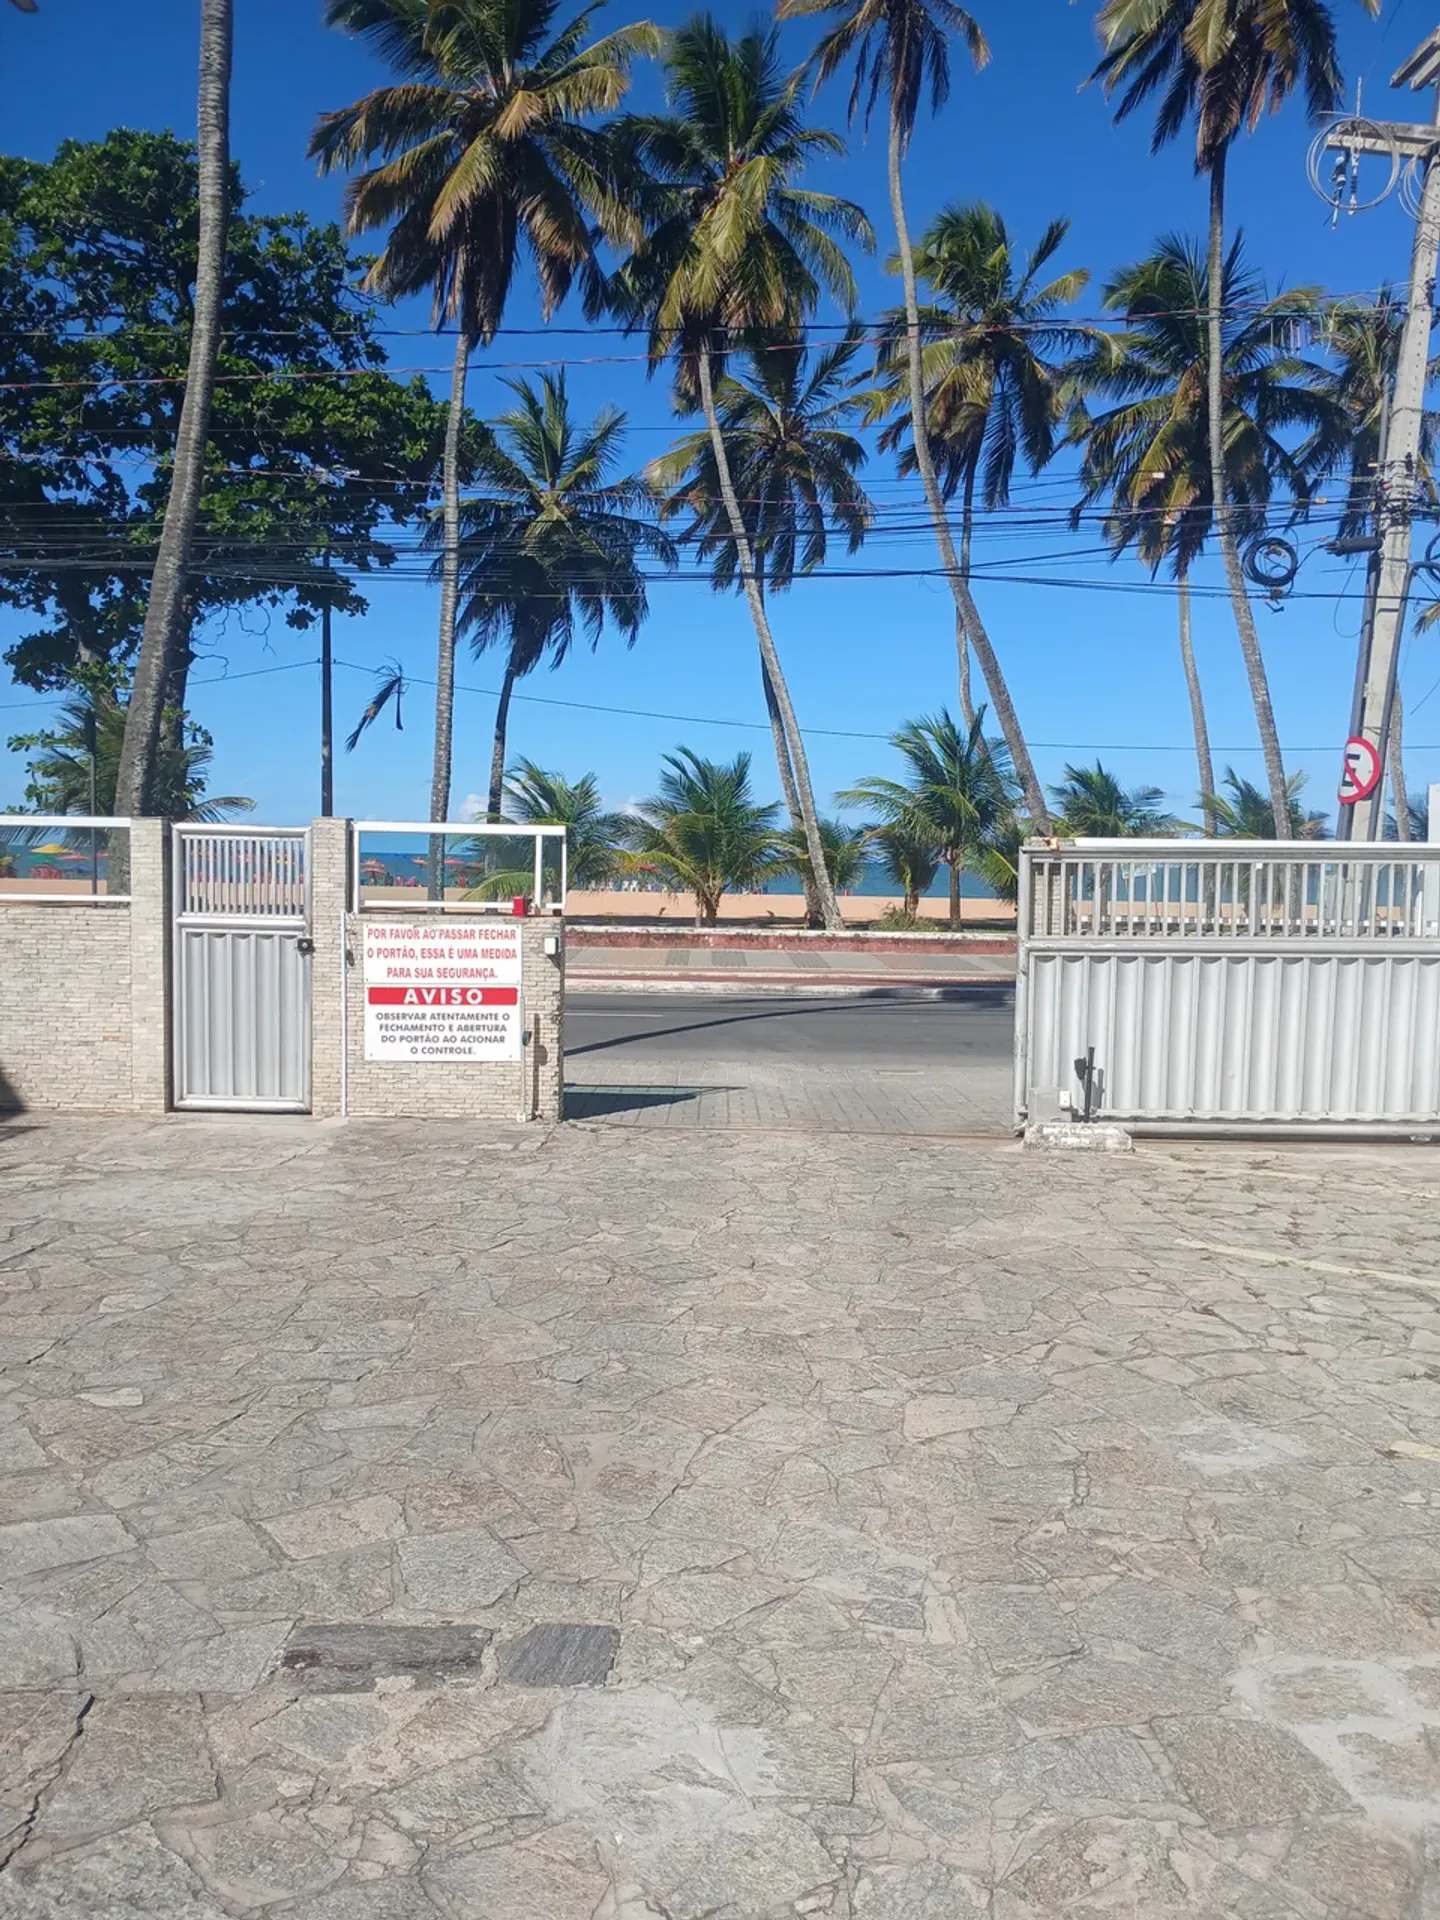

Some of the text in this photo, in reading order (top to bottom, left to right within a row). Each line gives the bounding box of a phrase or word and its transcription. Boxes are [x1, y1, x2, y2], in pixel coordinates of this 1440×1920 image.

[367, 928, 517, 940] POR FAVOR AO PASSAR FECHAR
[367, 945, 518, 961] O PORTÃO, ESSA É UMA MEDIDA
[386, 967, 499, 982] PARA SUA SEGURANÇA.
[403, 988, 483, 1006] AVISO
[375, 1012, 511, 1022] OBSERVAR ATENTAMENTE O
[379, 1023, 507, 1033] FECHAMENTO E ABERTURA
[380, 1032, 506, 1044] DO PORTÃO AO ACIONAR
[410, 1046, 477, 1056] O CONTROLE.
